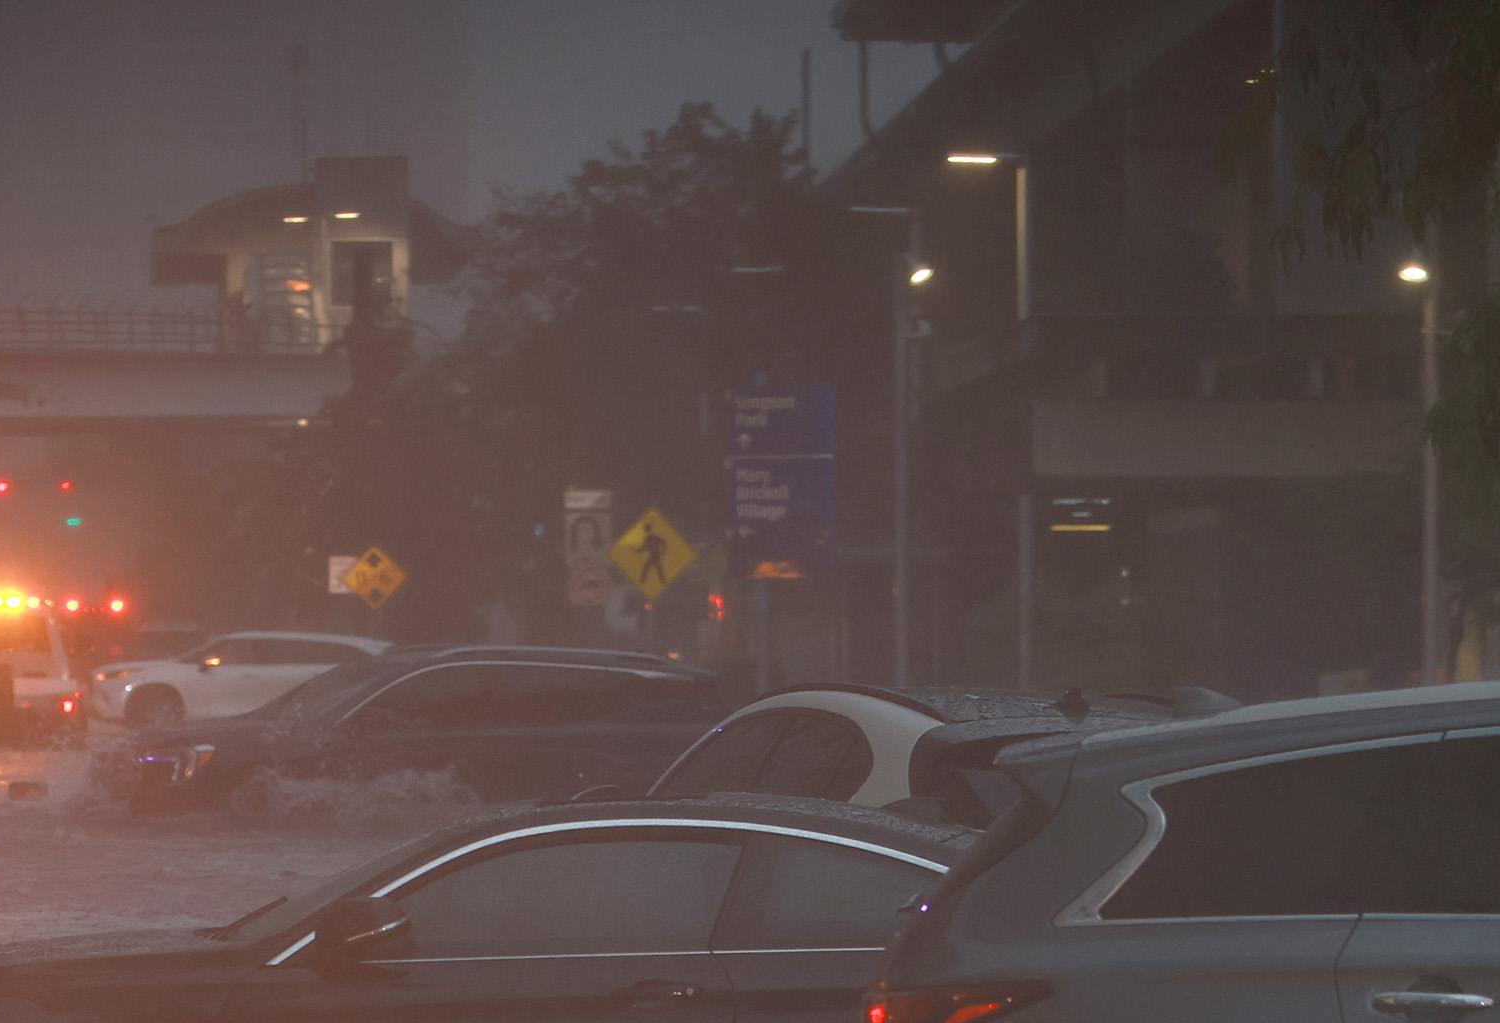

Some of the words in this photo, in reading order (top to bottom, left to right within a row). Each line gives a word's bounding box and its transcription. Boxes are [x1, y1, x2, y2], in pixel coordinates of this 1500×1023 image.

[735, 396, 796, 411] Simpson
[735, 413, 768, 426] Park
[736, 469, 772, 485] Mary
[736, 485, 791, 500] Brickell
[736, 503, 787, 521] Village
